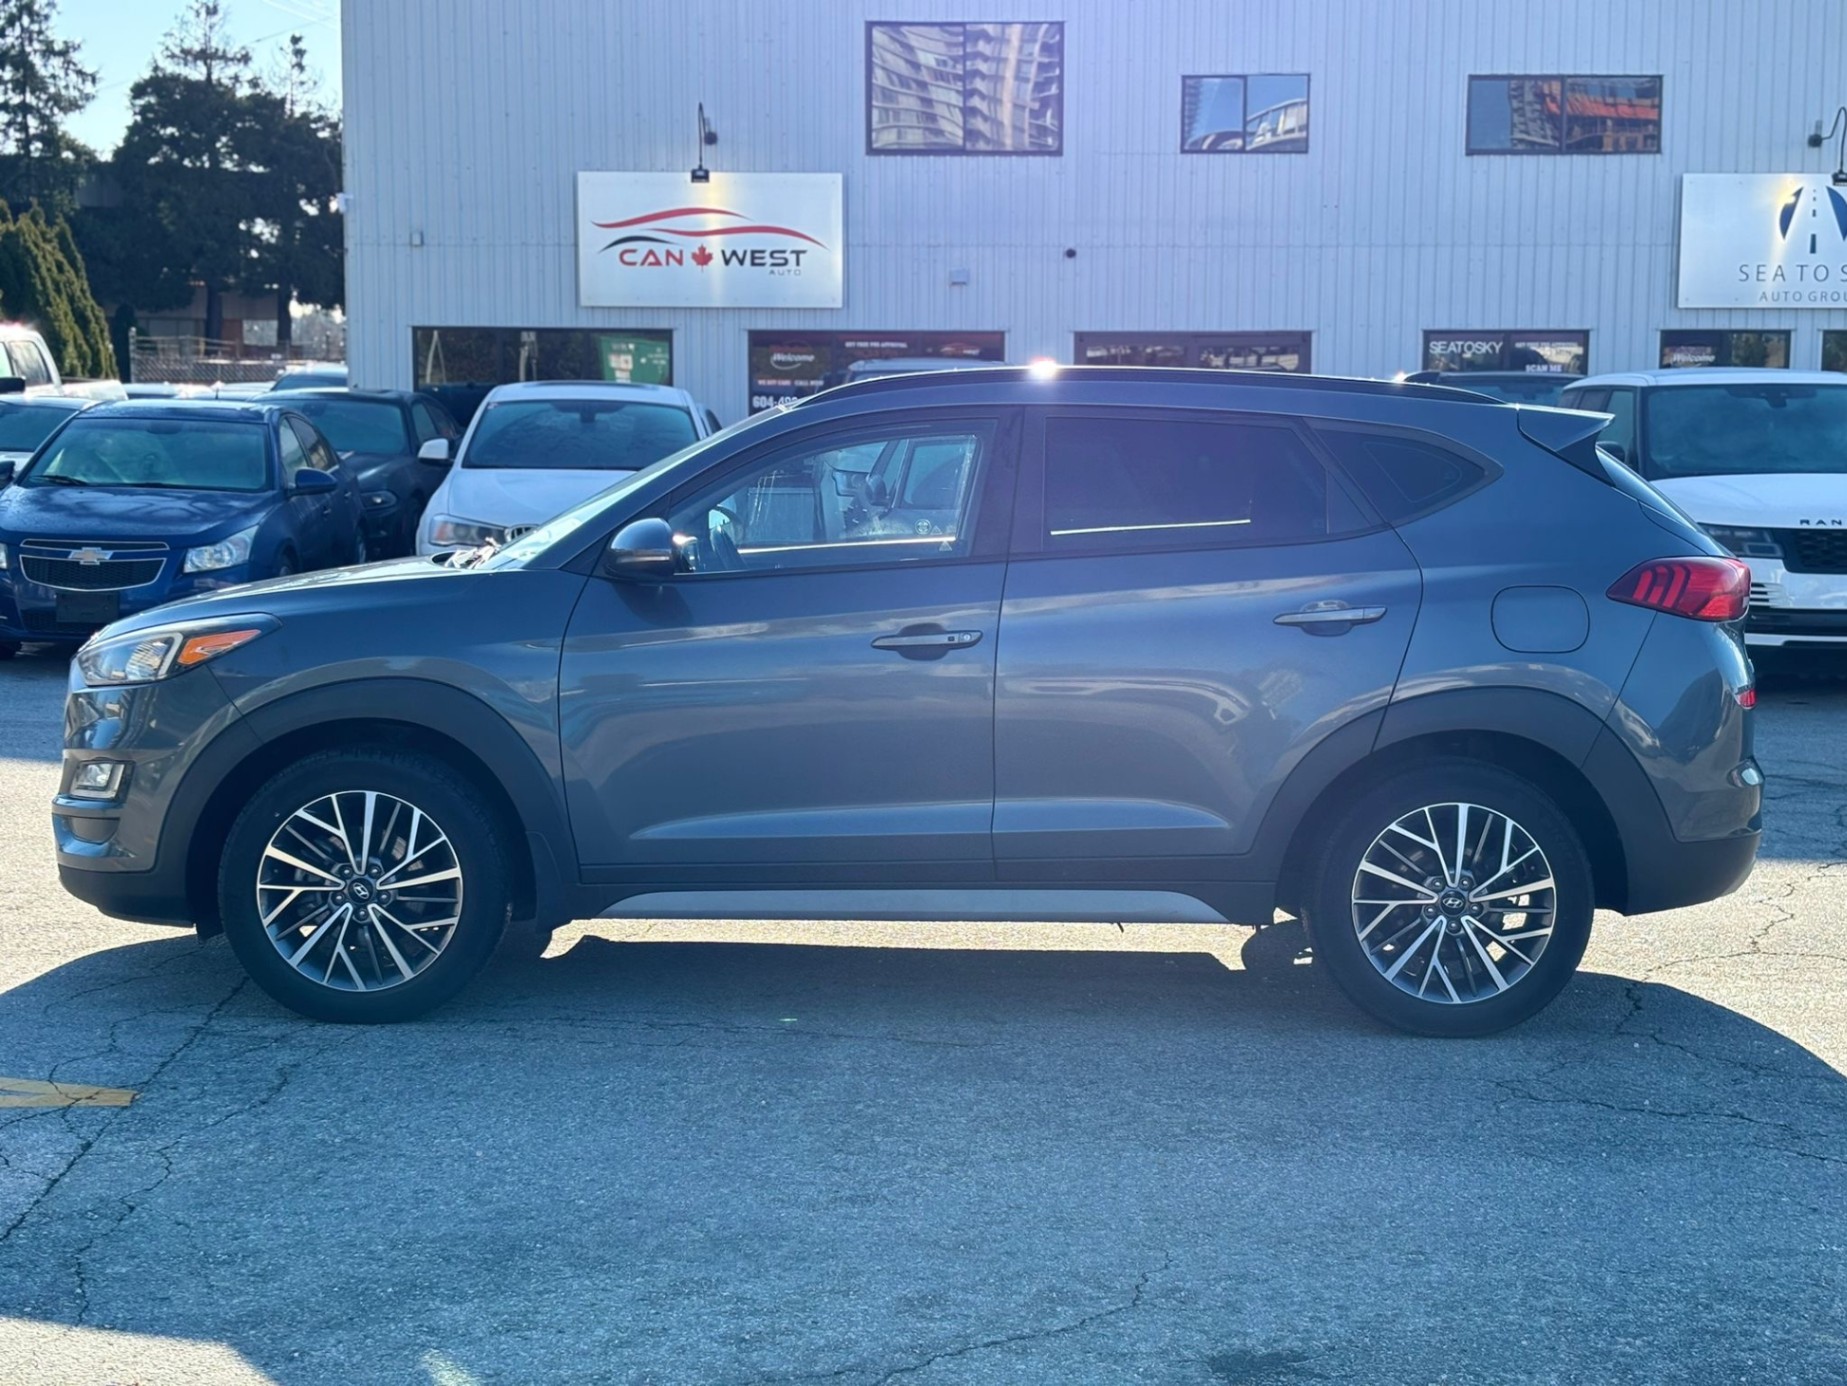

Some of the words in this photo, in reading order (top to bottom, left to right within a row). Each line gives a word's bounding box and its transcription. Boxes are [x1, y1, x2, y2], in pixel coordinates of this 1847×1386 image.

[619, 249, 684, 267] CAN
[721, 249, 807, 267] WEST
[1738, 264, 1786, 282] SEA
[1796, 264, 1830, 282] TO
[1759, 291, 1802, 302] AUTO
[1429, 341, 1503, 354] SEATOSKY
